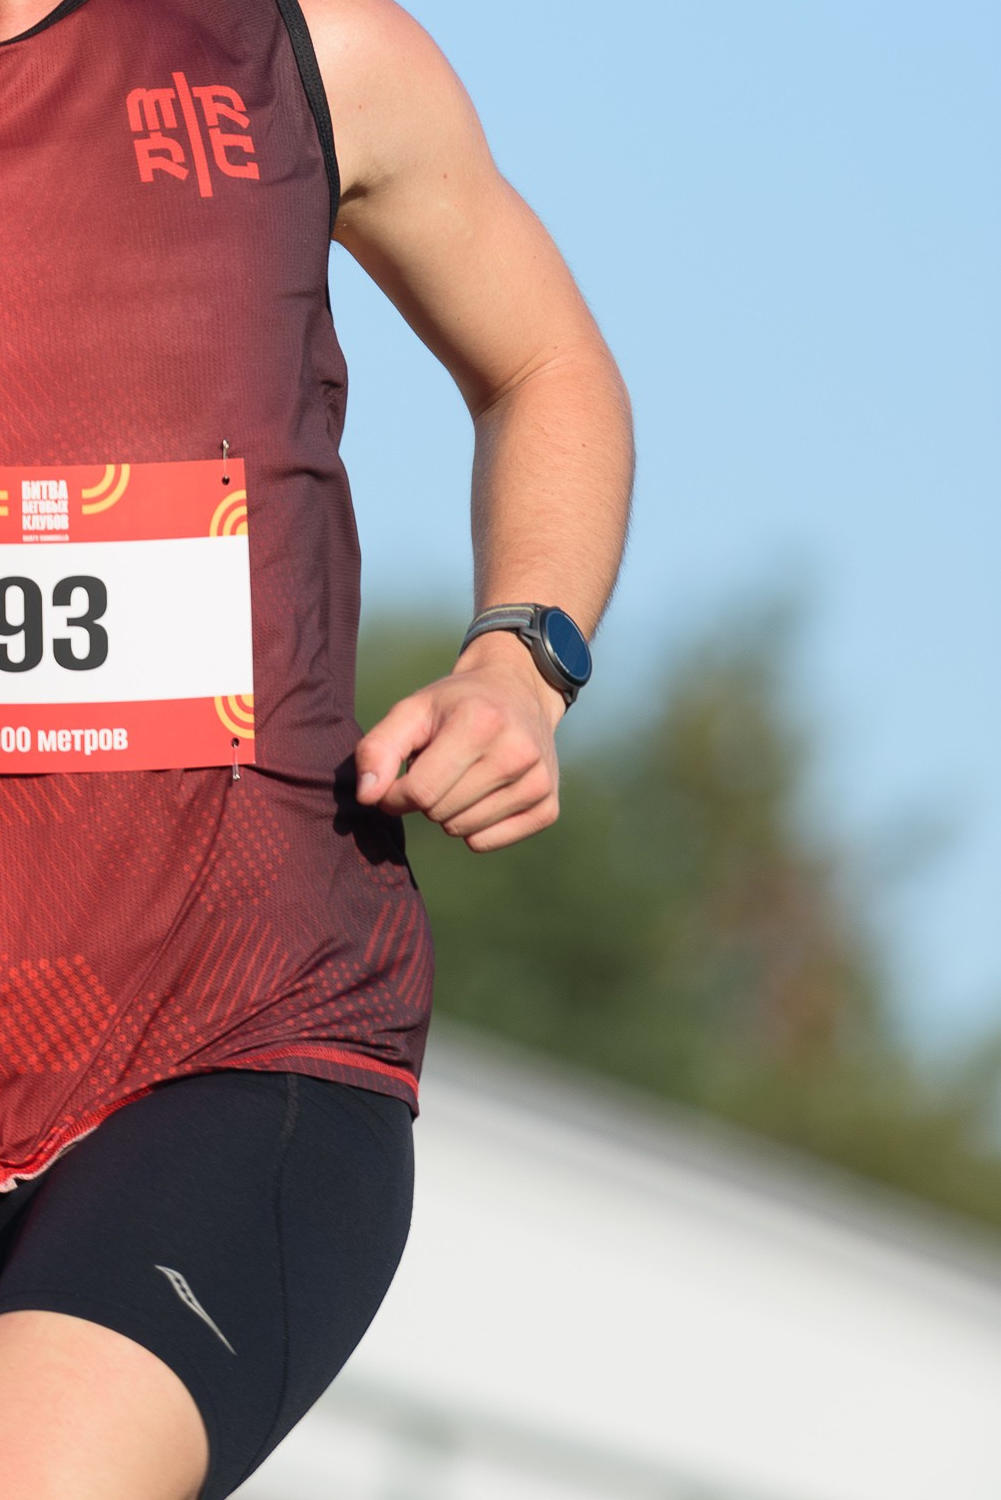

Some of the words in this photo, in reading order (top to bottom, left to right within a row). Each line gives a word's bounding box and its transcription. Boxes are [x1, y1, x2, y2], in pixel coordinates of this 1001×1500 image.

[21, 480, 69, 500] БИТВА
[21, 514, 69, 531] КЛУБОВ
[37, 727, 129, 756] метров
